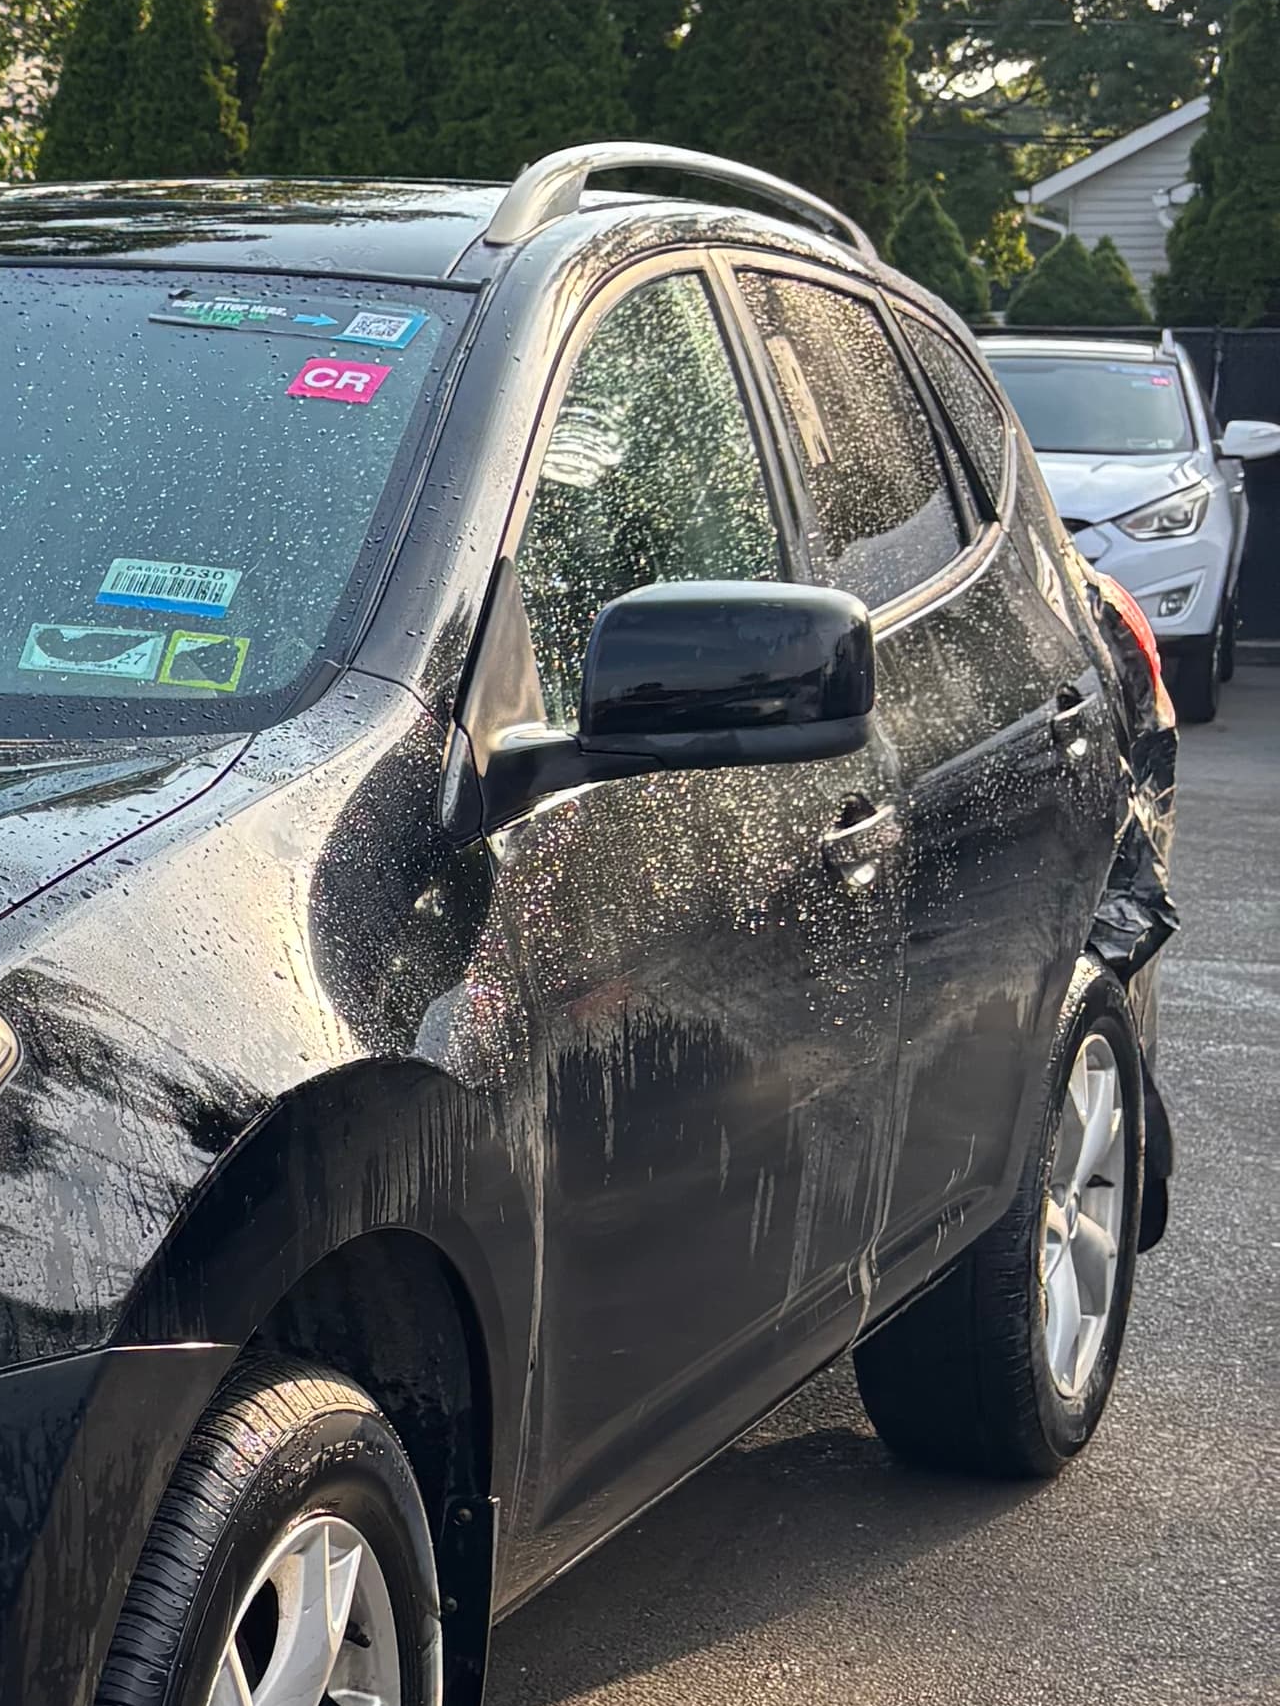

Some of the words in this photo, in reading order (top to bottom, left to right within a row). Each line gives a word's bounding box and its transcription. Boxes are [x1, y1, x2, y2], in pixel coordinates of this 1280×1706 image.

[213, 302, 250, 312] STOP
[303, 367, 372, 393] CR
[117, 653, 148, 666] 27
